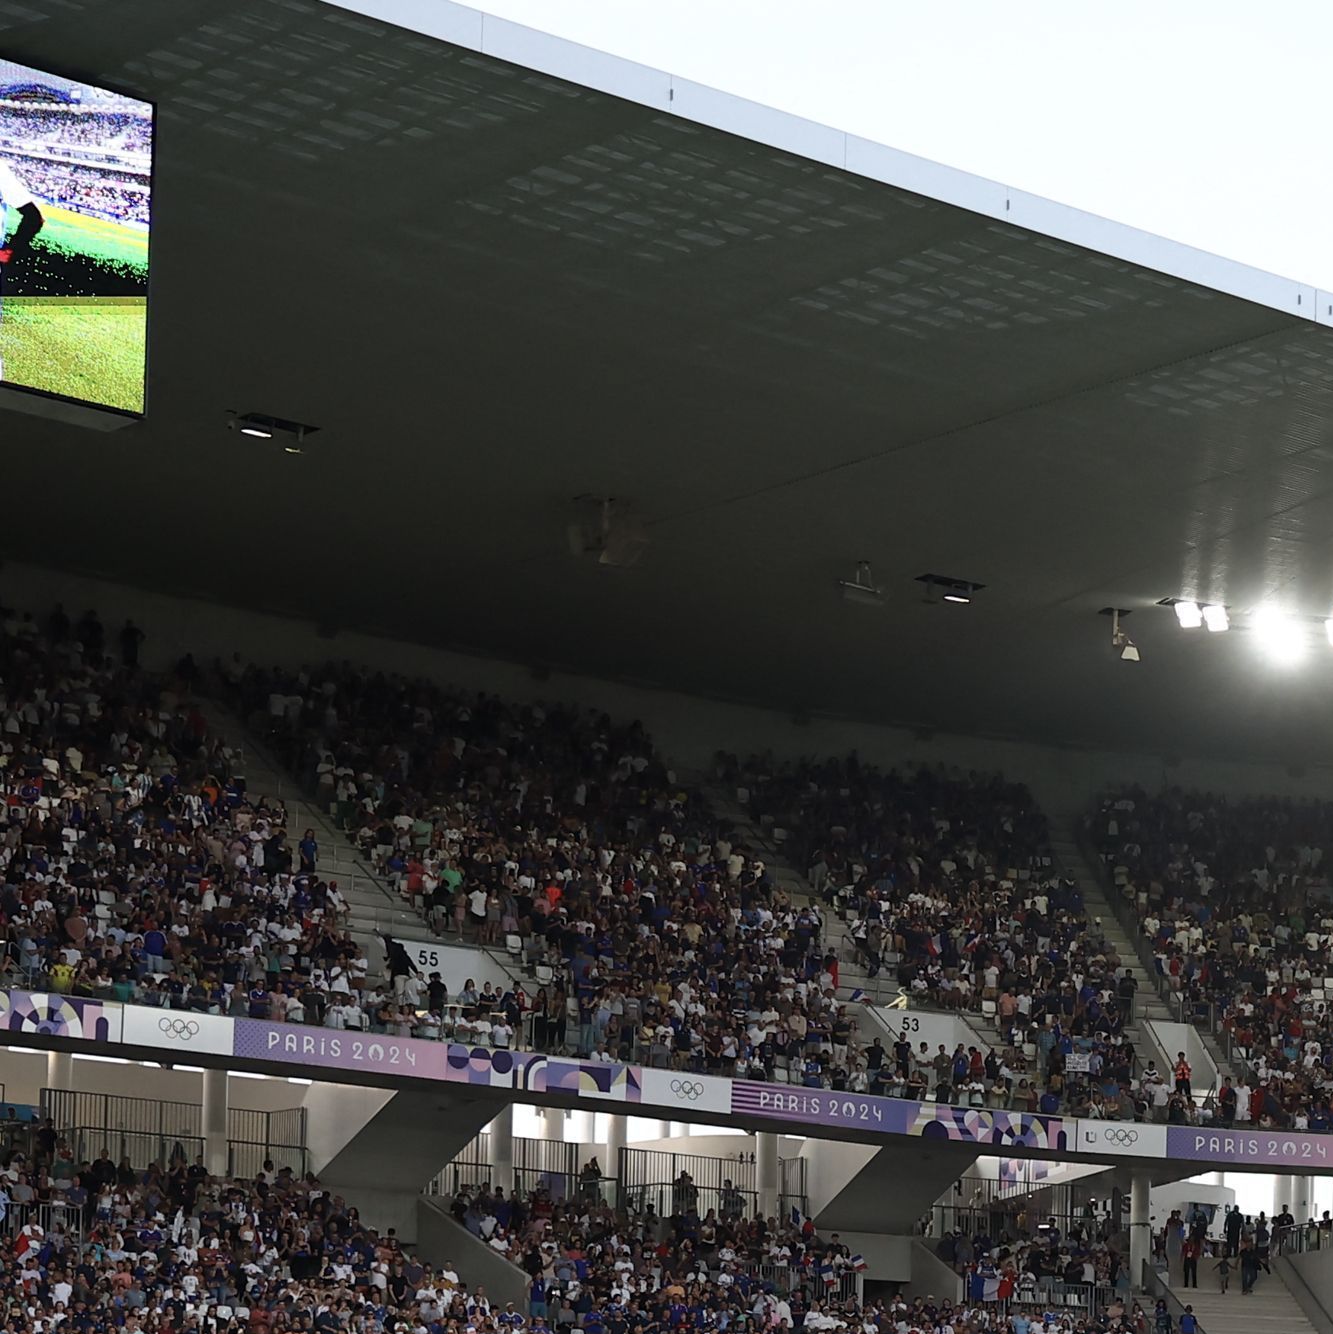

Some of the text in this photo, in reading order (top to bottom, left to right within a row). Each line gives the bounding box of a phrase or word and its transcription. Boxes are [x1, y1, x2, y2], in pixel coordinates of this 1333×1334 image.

[418, 950, 439, 967] 55
[901, 1016, 920, 1033] 53
[352, 1042, 417, 1067] 2024
[828, 1100, 883, 1123] 2024
[1267, 1140, 1328, 1159] 2024
